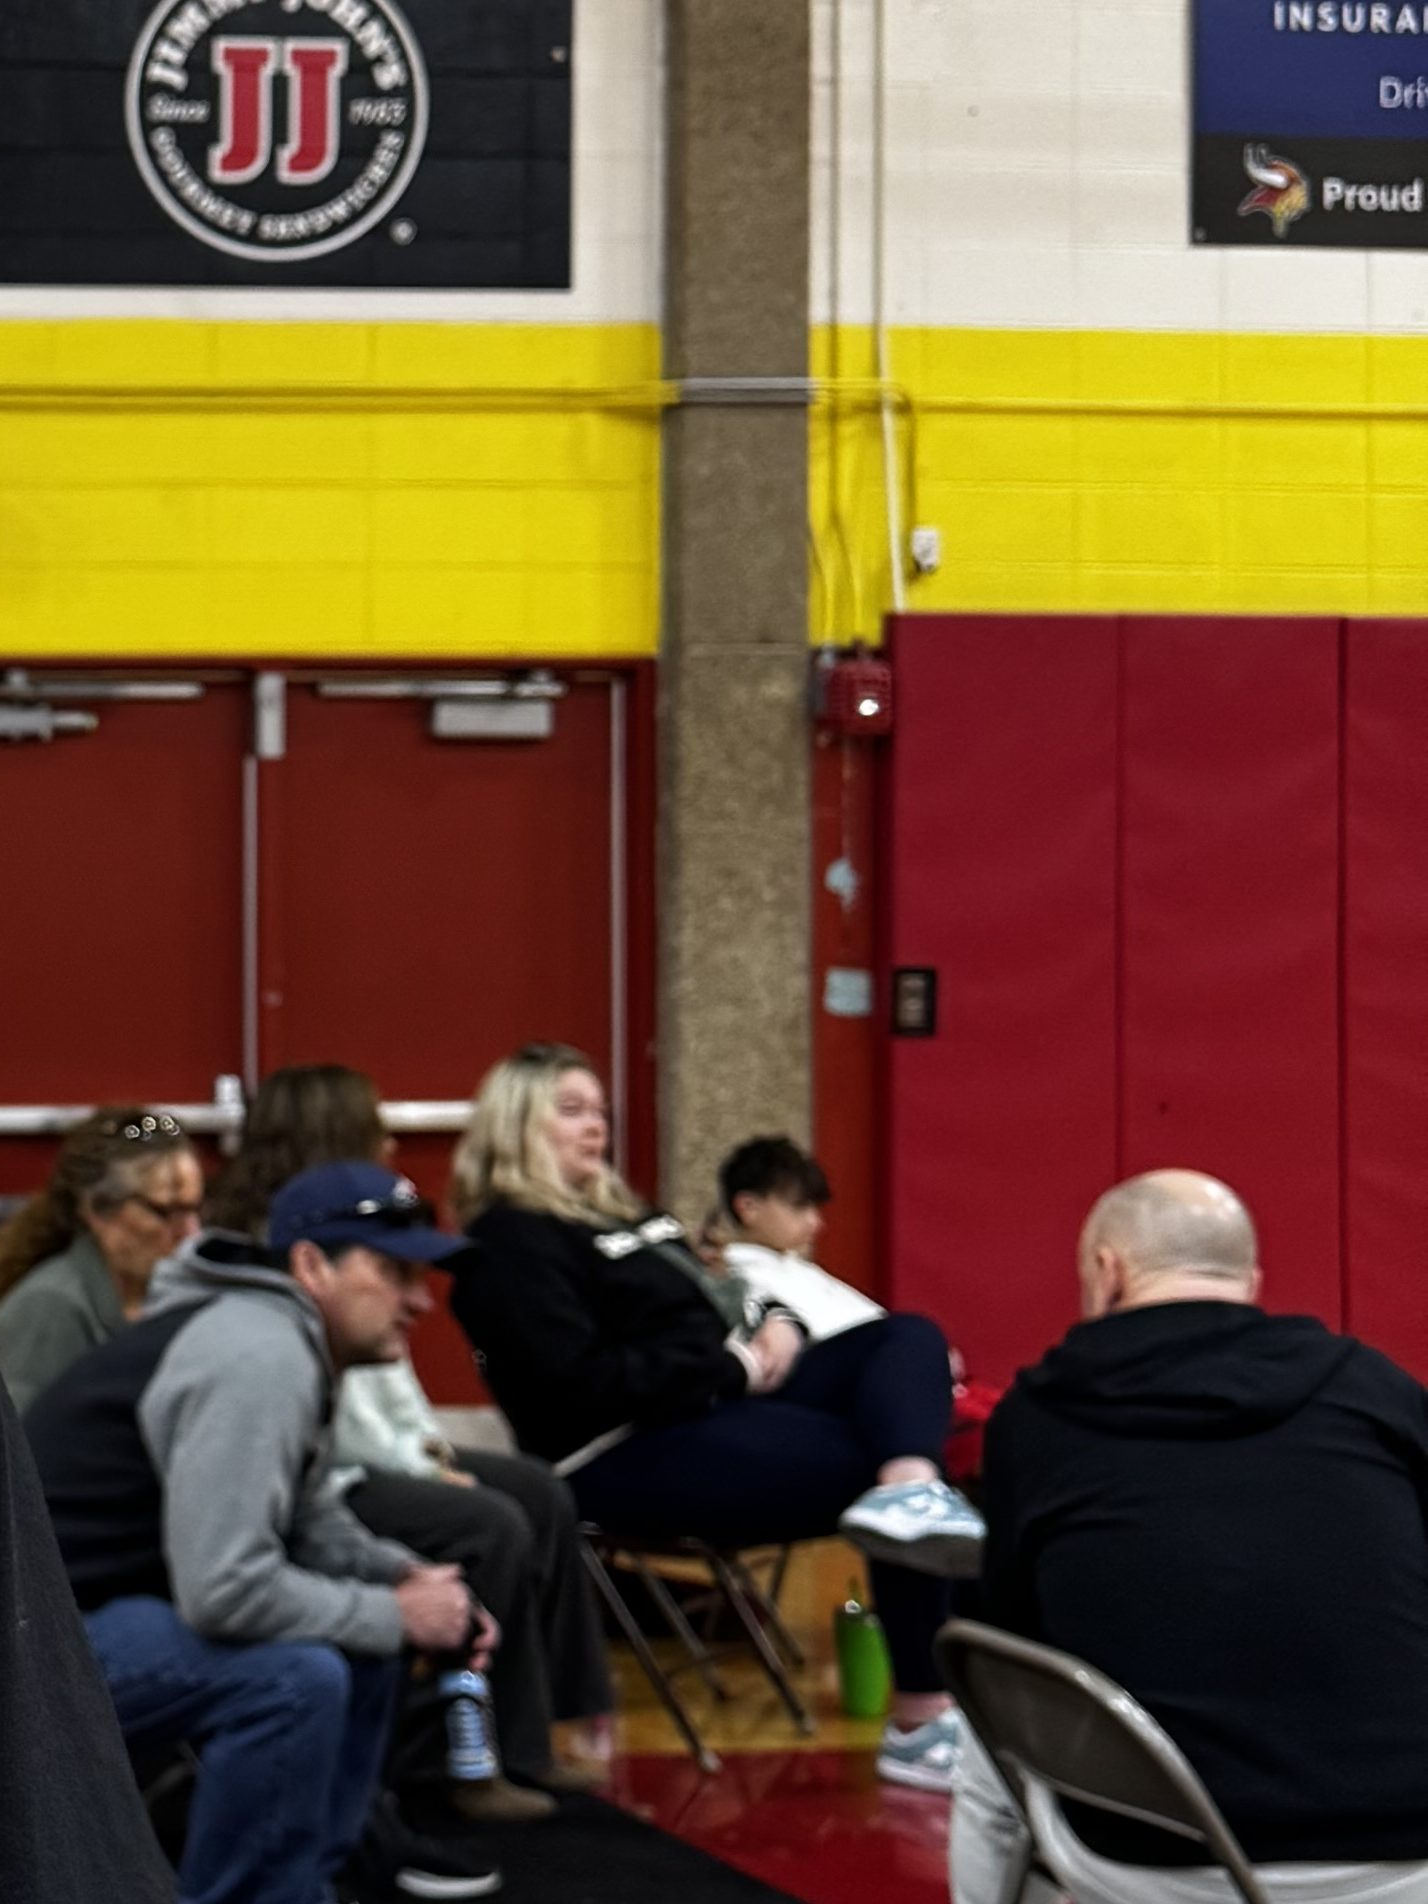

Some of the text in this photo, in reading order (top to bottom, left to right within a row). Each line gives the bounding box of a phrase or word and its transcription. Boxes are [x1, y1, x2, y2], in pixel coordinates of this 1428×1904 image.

[1274, 0, 1428, 34] INSURA
[208, 34, 350, 186] JJ
[1322, 177, 1424, 212] Proud
